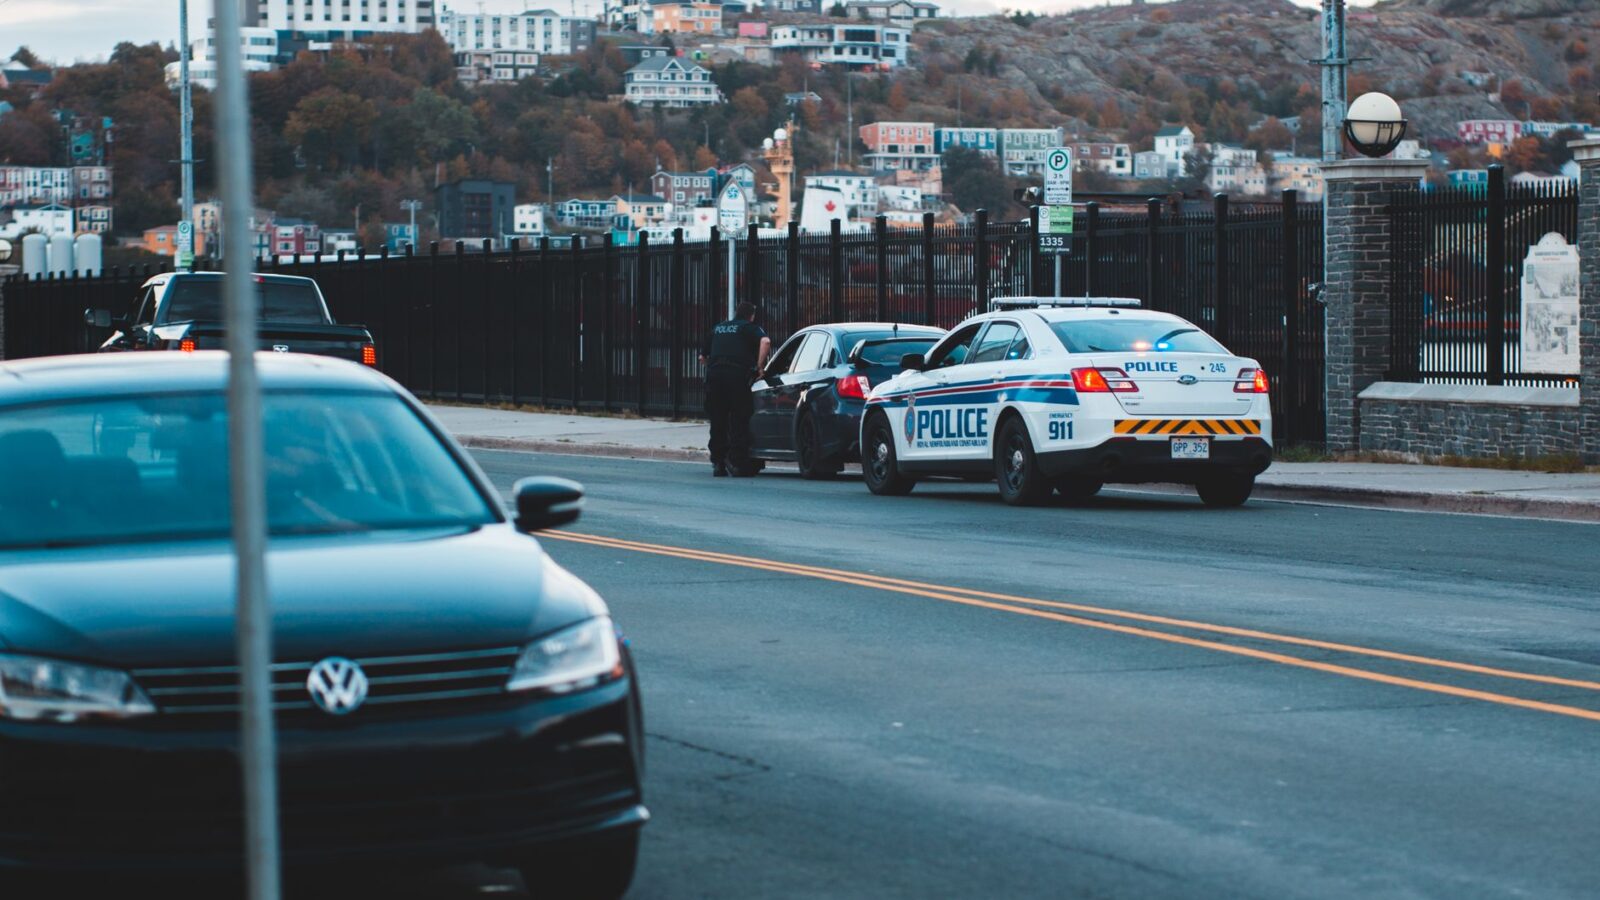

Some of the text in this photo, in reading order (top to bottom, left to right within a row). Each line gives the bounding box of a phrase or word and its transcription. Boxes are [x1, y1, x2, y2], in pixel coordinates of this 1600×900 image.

[1040, 237, 1064, 246] 1335
[714, 325, 739, 334] POLICE
[1124, 362, 1178, 372] POLICE
[1209, 363, 1226, 373] 245
[917, 408, 988, 439] POLICE
[1048, 421, 1073, 440] 911
[1173, 442, 1207, 453] GPP 352
